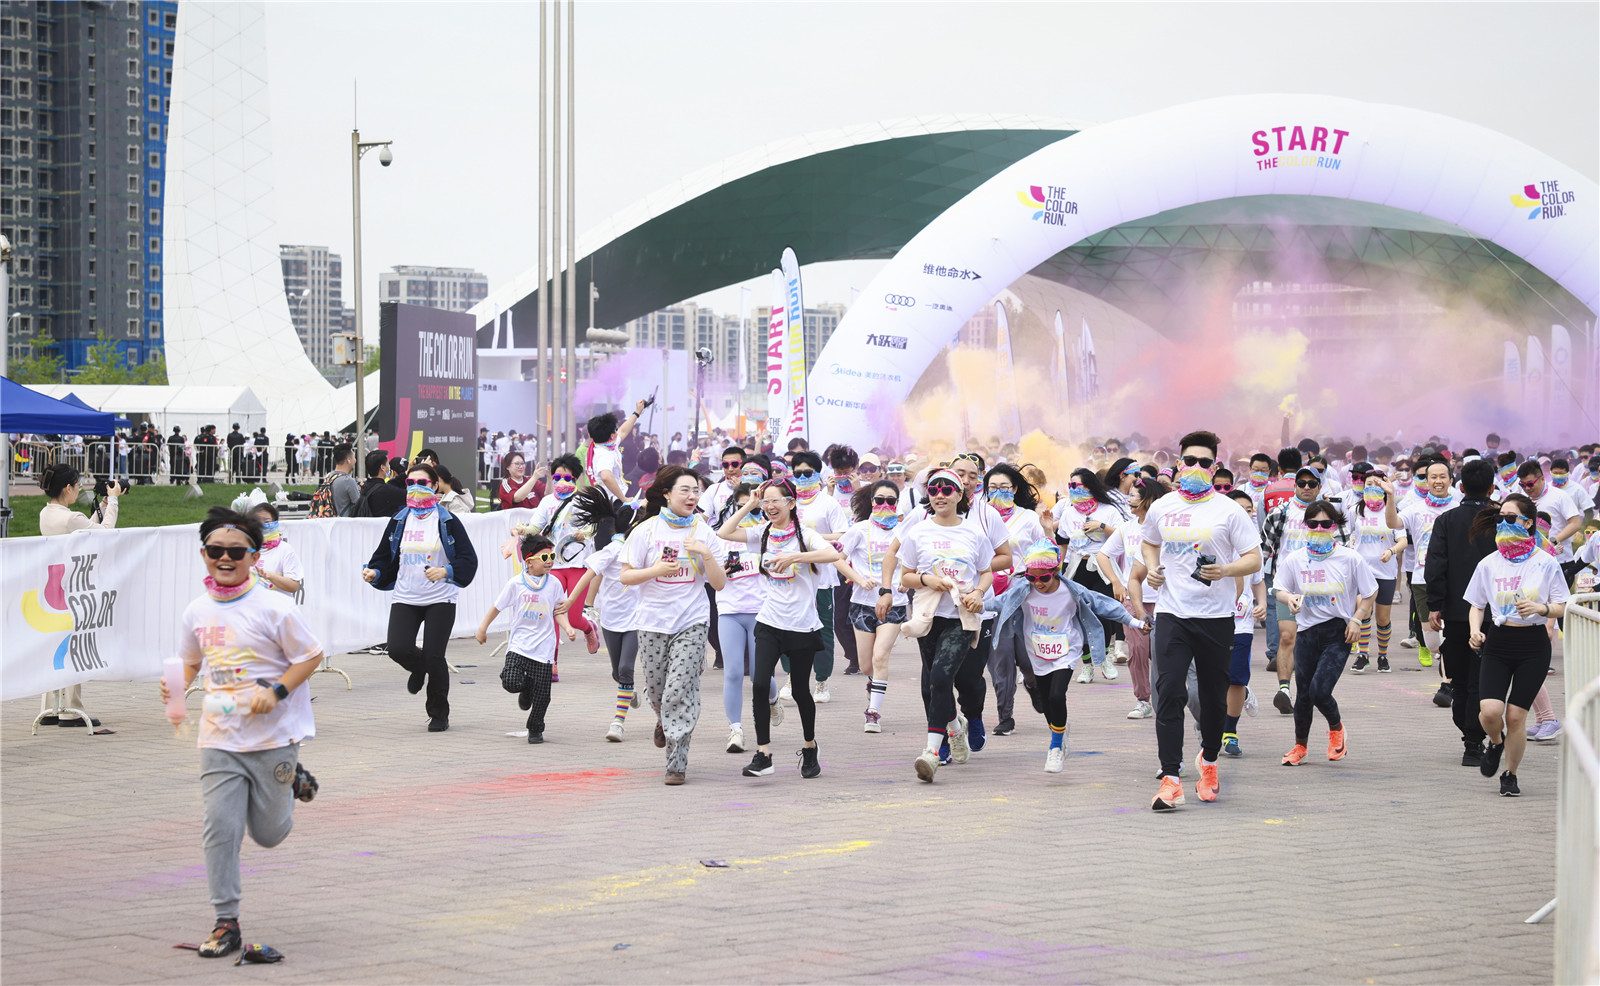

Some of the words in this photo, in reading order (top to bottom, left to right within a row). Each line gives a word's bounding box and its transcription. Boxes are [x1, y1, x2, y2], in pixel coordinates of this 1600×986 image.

[1252, 126, 1349, 156] START
[1048, 186, 1066, 200] THE
[1540, 180, 1559, 193] THE
[1542, 191, 1575, 206] COLOR
[1046, 199, 1078, 215] COLOR
[923, 263, 971, 280] 维他命水
[418, 331, 433, 377] THE
[434, 332, 457, 379] COLOR
[766, 305, 784, 395] START
[827, 398, 844, 407] NCI
[769, 418, 781, 426] THE
[1164, 514, 1192, 527] THE
[1360, 518, 1378, 526] THE
[403, 530, 424, 542] THE
[1163, 528, 1212, 542] COLOR
[1361, 535, 1380, 544] RUN
[932, 541, 951, 549] THE
[1164, 541, 1193, 555] RUN
[403, 553, 427, 565] RUN
[69, 553, 98, 593] THE
[1300, 569, 1326, 583] THE
[1303, 583, 1345, 596] COLOR
[1495, 576, 1521, 592] THE
[523, 594, 539, 603] THE
[1304, 595, 1331, 608] RUN
[68, 590, 117, 632] COLOR
[1031, 606, 1048, 616] THE
[1032, 614, 1063, 626] COLOR
[1037, 643, 1062, 655] 15542
